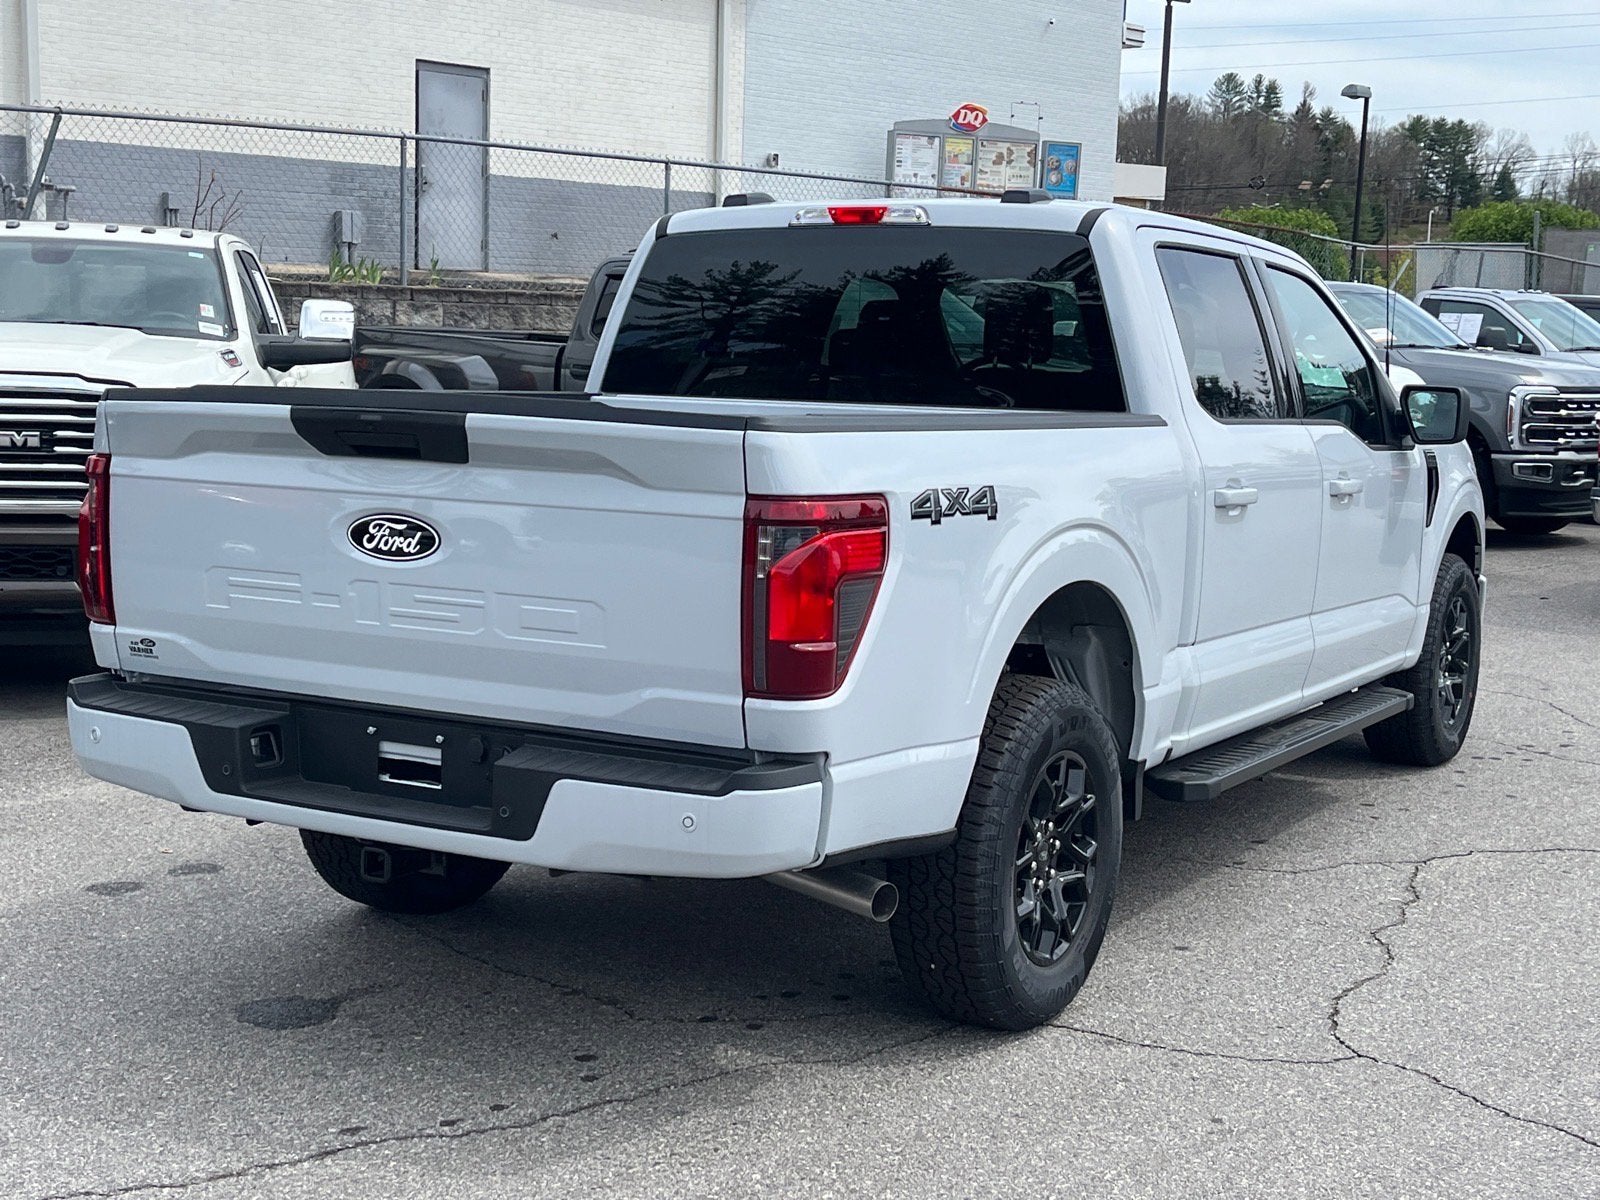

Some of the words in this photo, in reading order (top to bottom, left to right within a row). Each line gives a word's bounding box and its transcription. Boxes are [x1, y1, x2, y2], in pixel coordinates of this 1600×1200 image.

[958, 109, 983, 128] DQ
[363, 520, 422, 553] Ford
[205, 565, 608, 649] F-150
